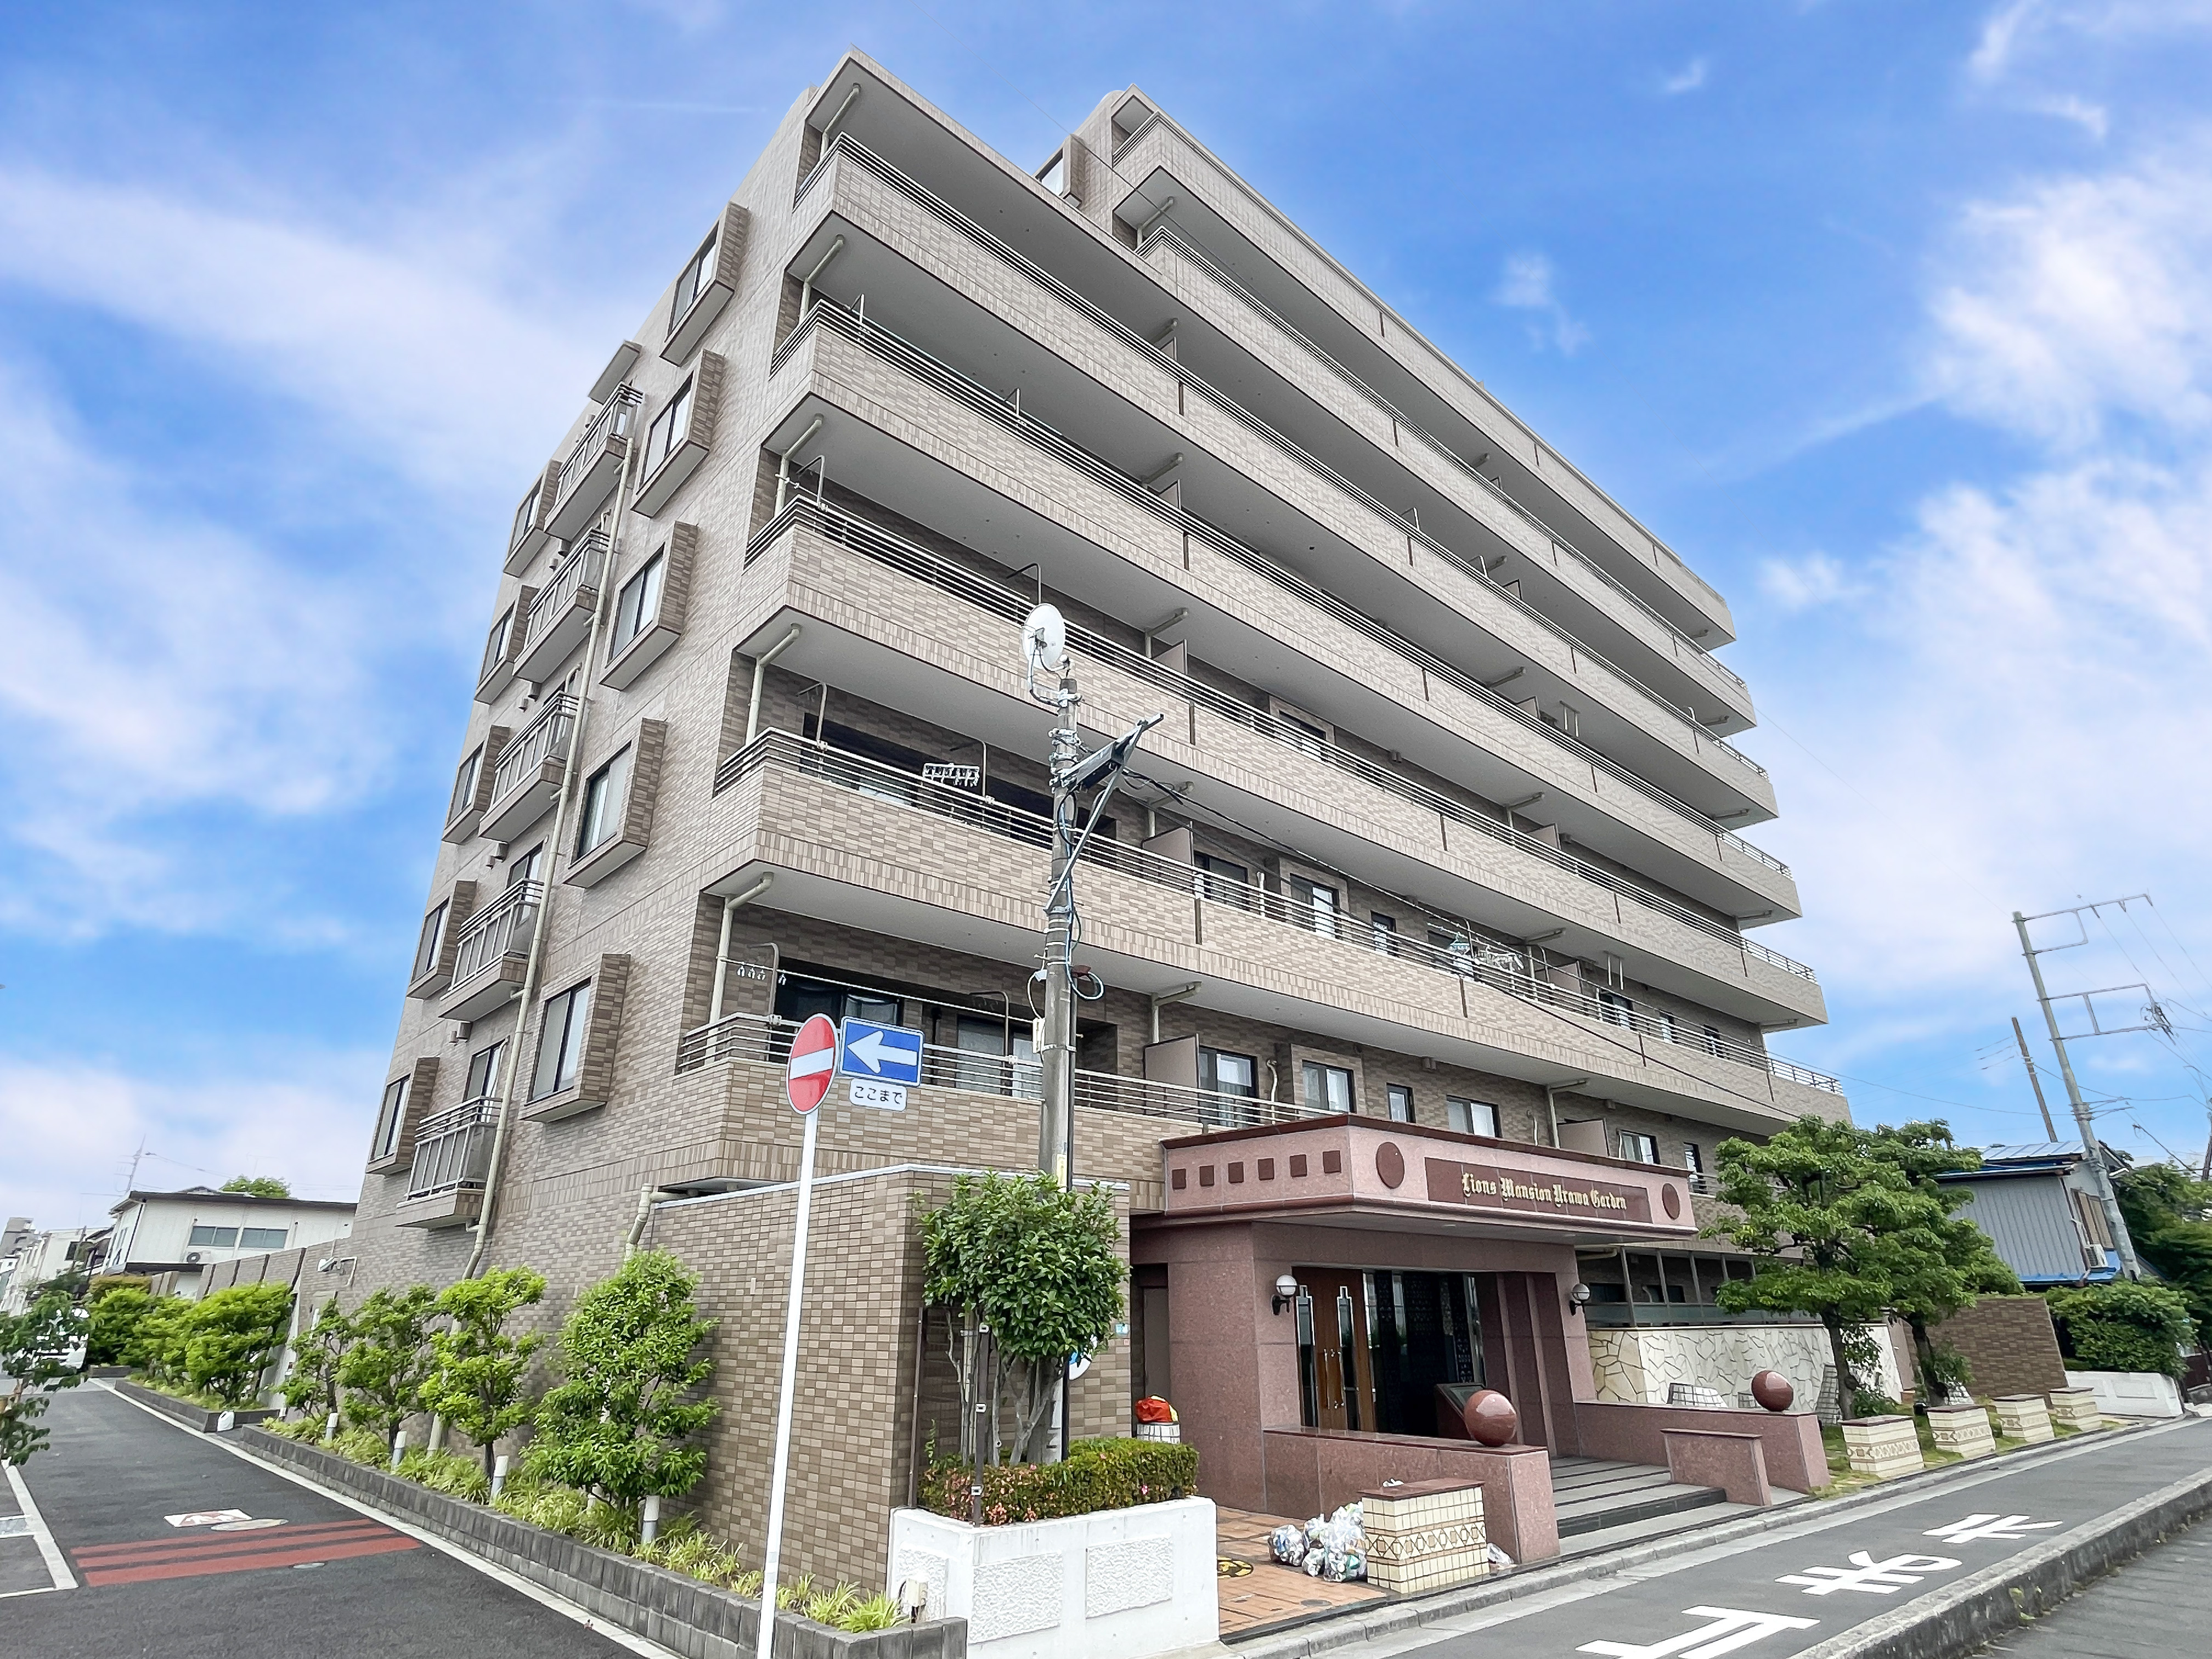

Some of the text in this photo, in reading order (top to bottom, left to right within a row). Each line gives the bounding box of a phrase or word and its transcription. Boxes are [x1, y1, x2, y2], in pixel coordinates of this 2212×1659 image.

[854, 1085, 902, 1105] ここまで
[1462, 1172, 1627, 1210] Lions Mansion Urawa Garden
